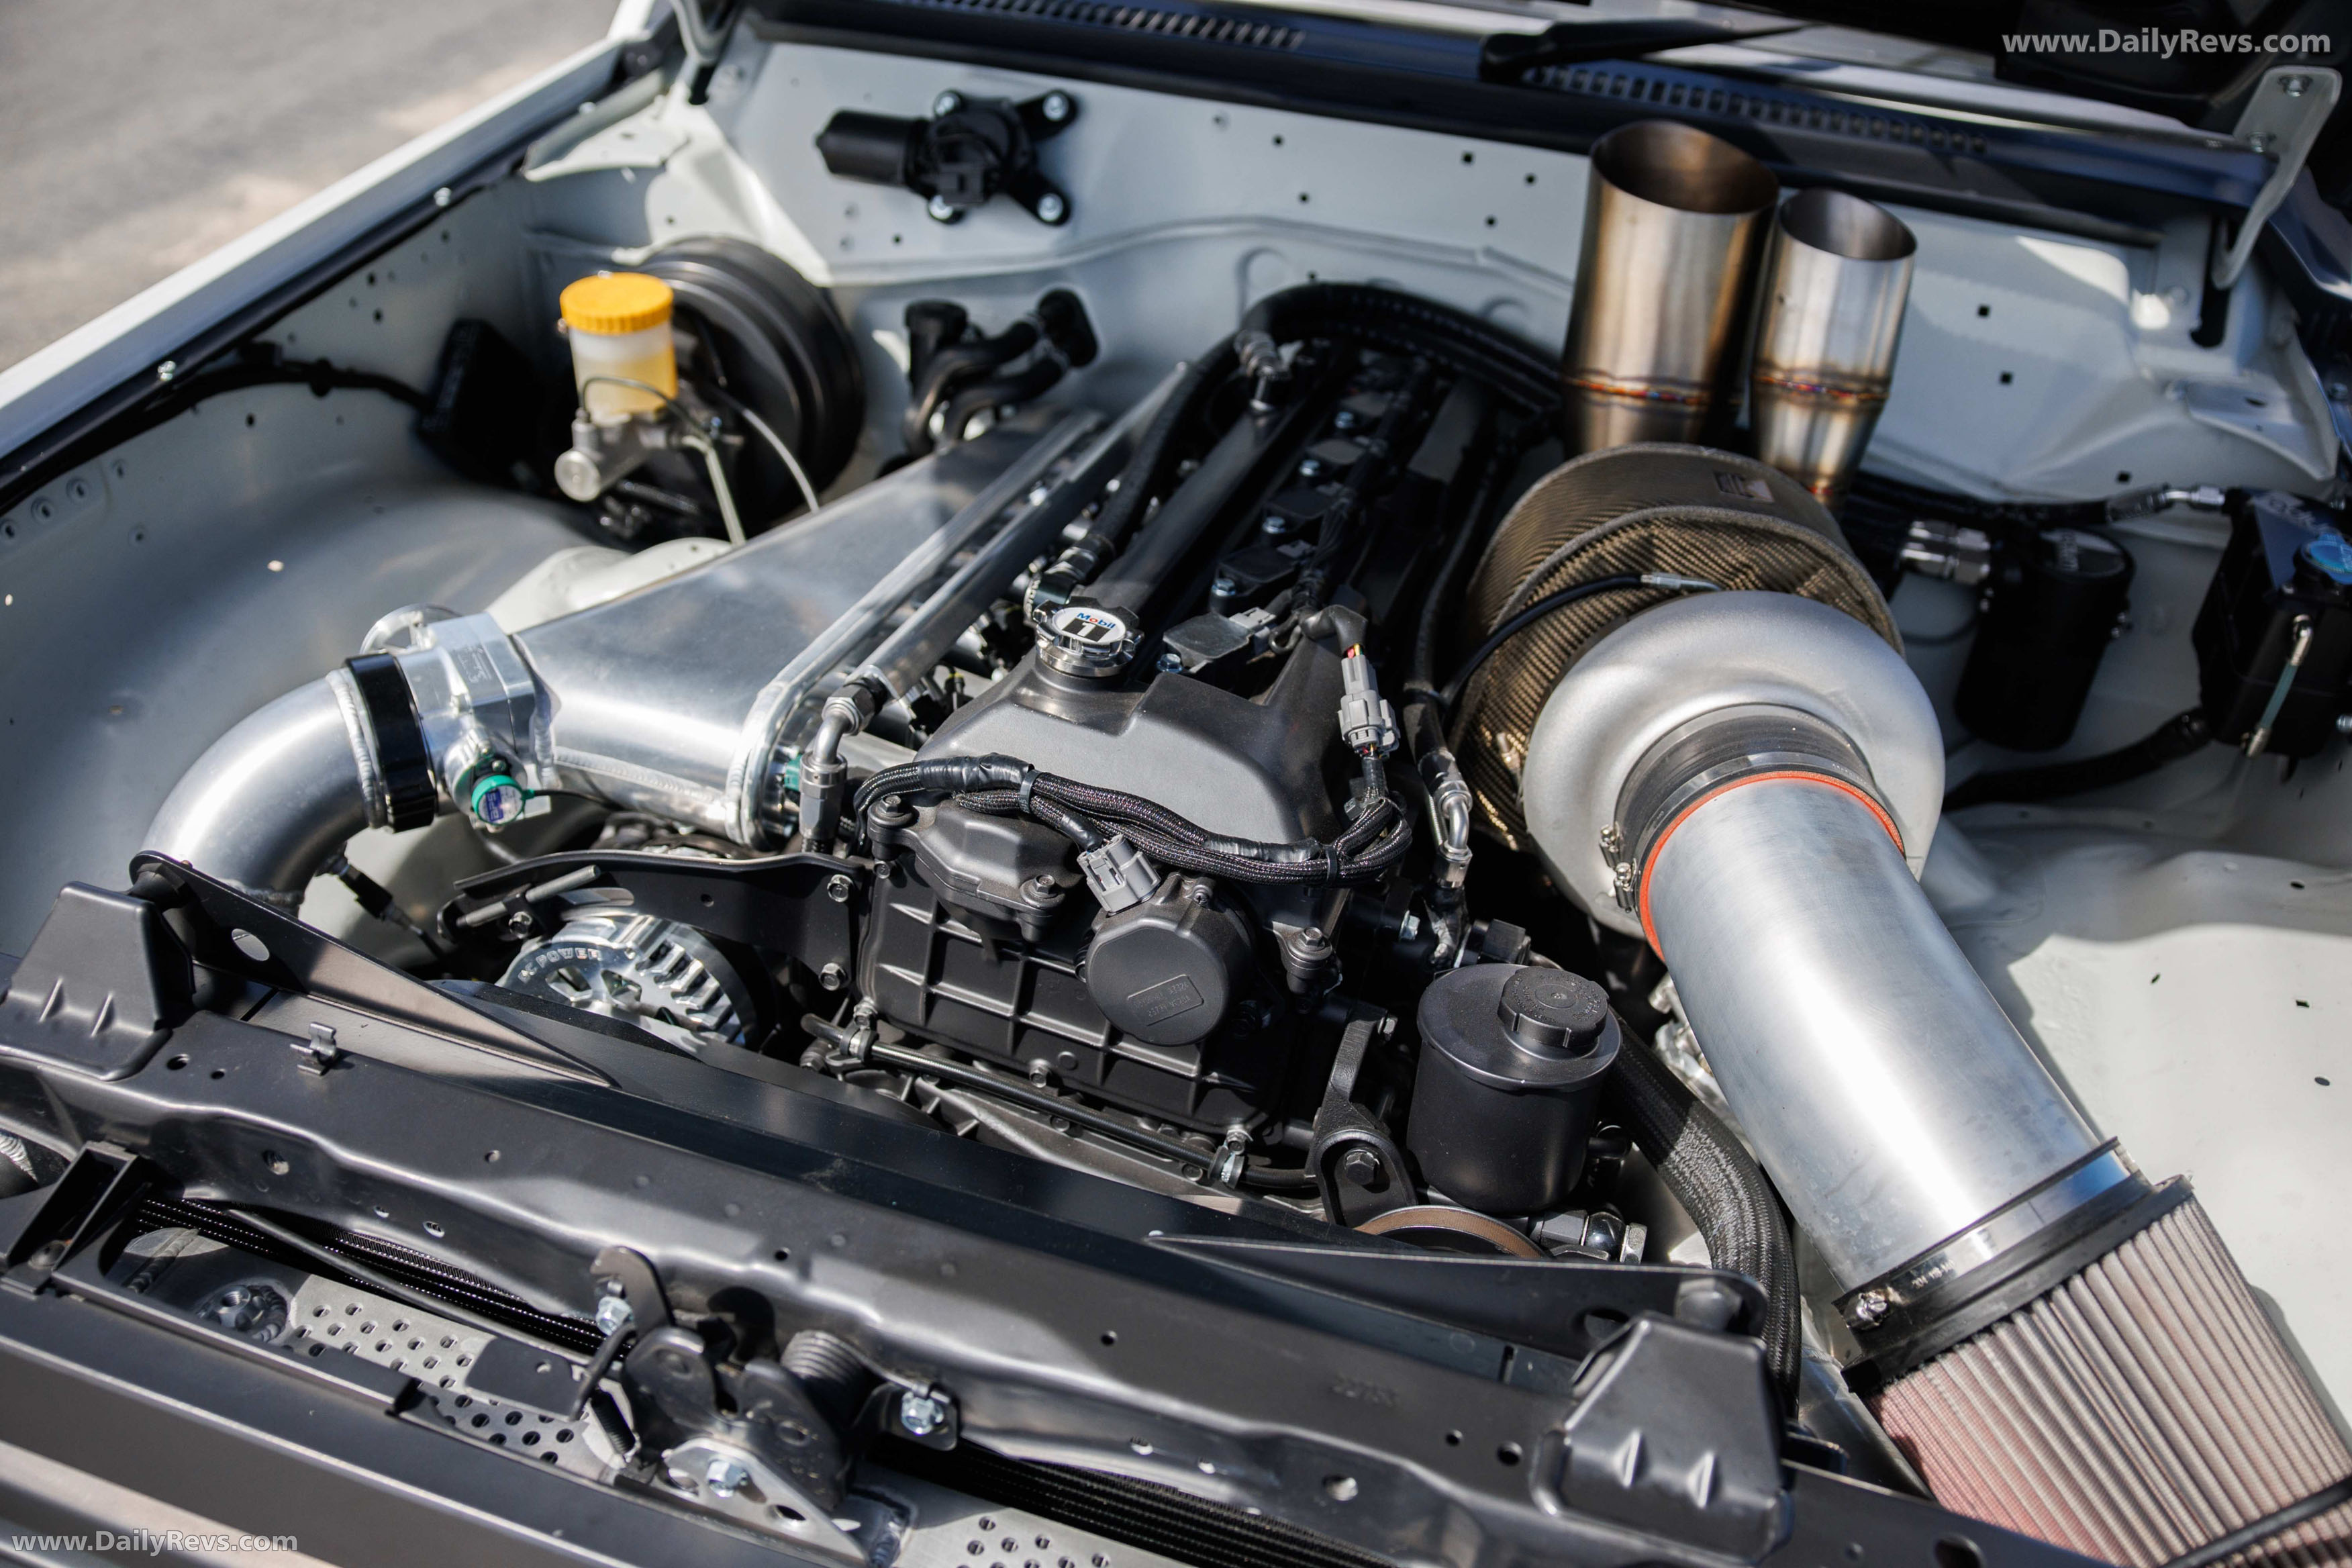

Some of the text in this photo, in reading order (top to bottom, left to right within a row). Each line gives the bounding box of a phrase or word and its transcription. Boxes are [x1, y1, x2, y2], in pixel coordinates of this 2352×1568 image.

[1075, 612, 1116, 629] Mobil
[1077, 622, 1096, 638] 1
[536, 947, 602, 968] POWER
